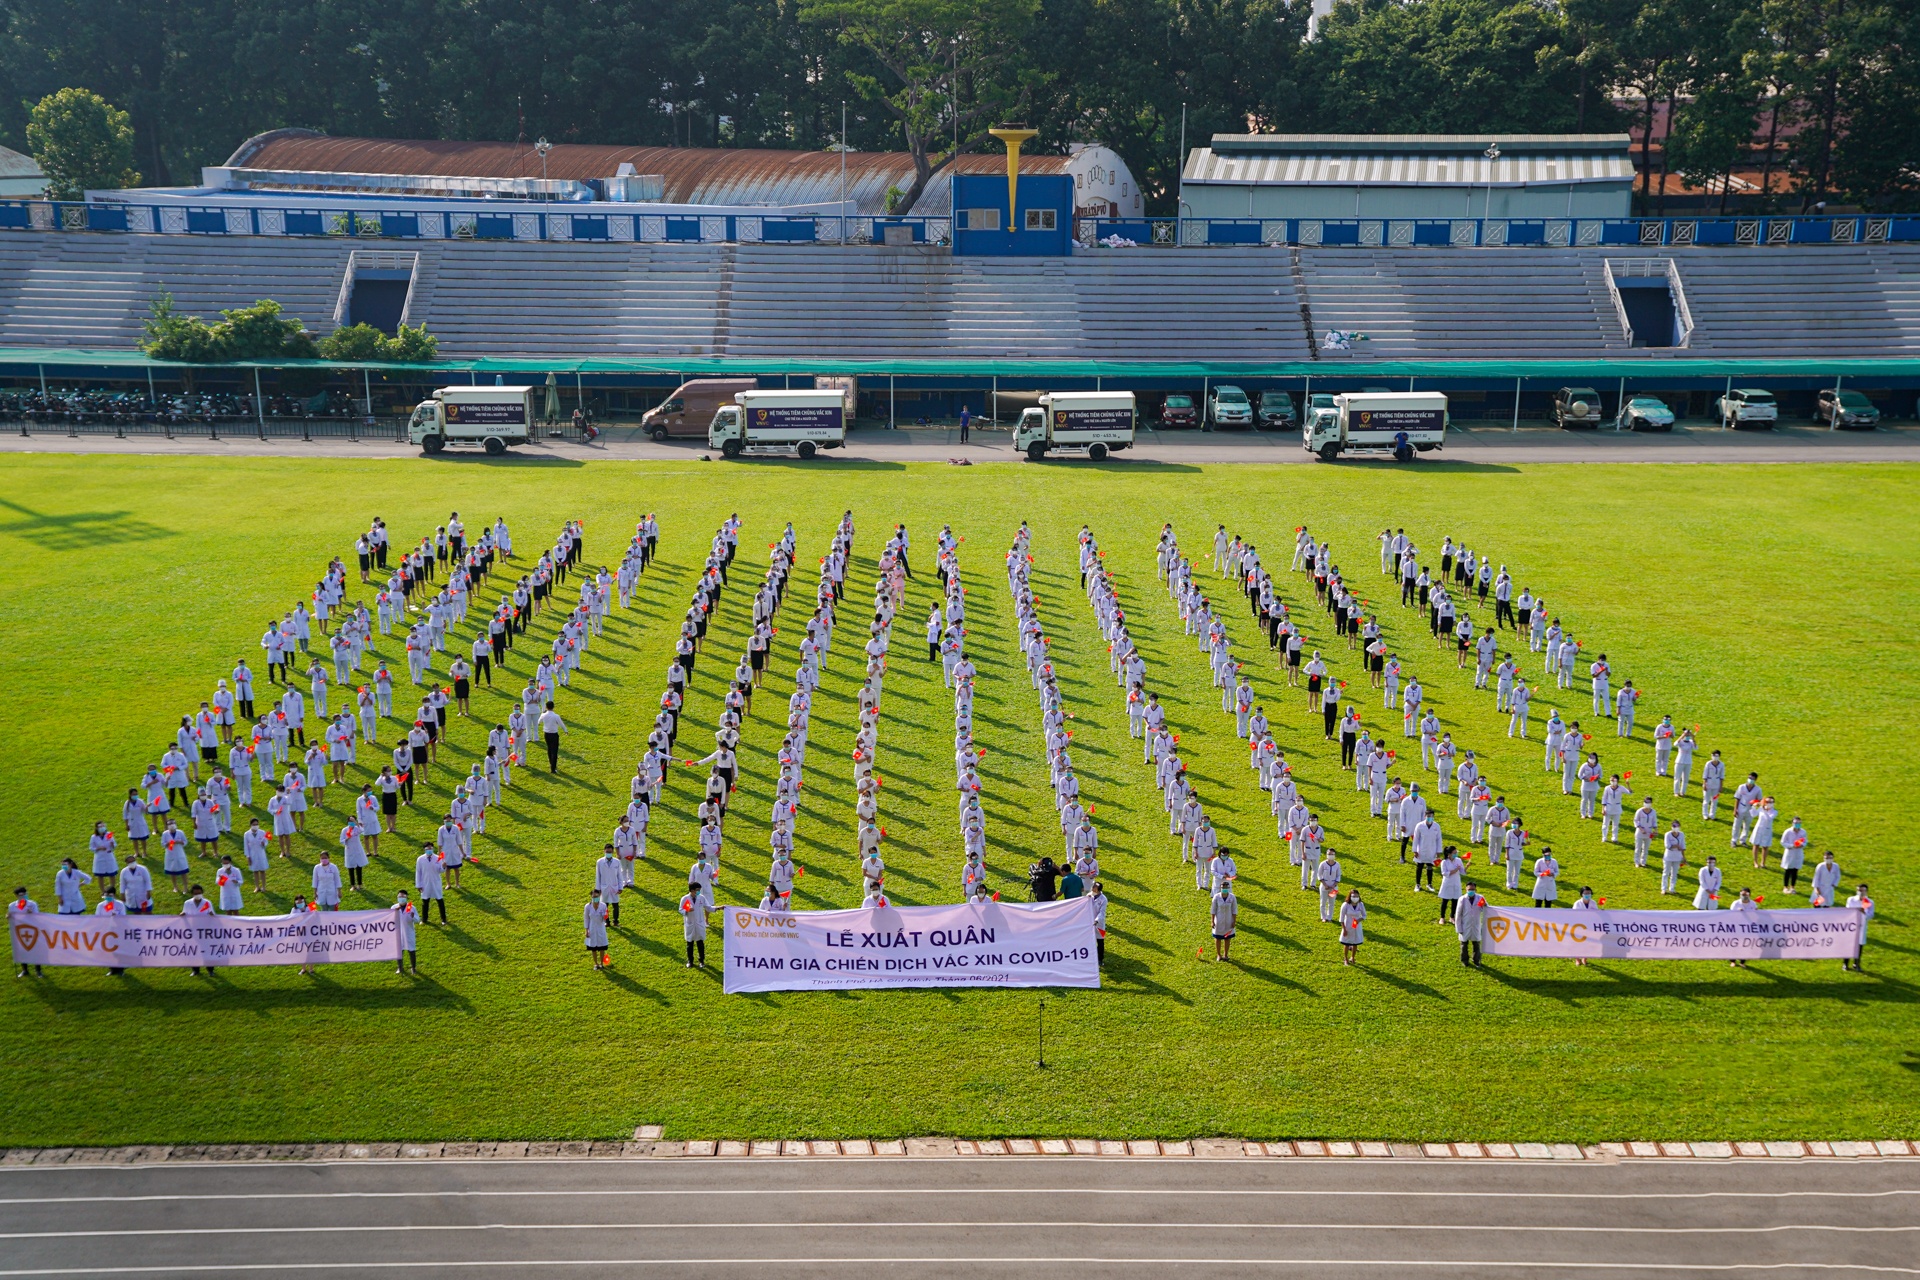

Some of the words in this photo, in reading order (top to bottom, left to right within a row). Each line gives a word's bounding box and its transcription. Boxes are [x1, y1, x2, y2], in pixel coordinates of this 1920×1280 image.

[124, 927, 141, 942] HỆ
[196, 928, 242, 939] TRUNG
[246, 925, 273, 938] TÂM
[277, 924, 307, 937] TIÊM
[310, 922, 357, 936] CHỦNG
[360, 921, 396, 934] VNVC
[753, 916, 797, 928] VNVC
[1513, 921, 1588, 943] VNVC
[1593, 922, 1611, 934] HỆ
[1661, 923, 1706, 933] TRUNG
[1709, 921, 1736, 933] TÂM
[1738, 922, 1769, 933] TIÊM
[1822, 922, 1857, 932] VNVC
[41, 929, 119, 953] VNVC
[826, 928, 854, 948] LỄ
[861, 928, 923, 948] XUẤT
[929, 924, 995, 947] QUÂN
[1664, 935, 1689, 947] TÂM
[1742, 937, 1774, 949] DỊCH
[1776, 937, 1834, 947] COVID-19
[138, 945, 158, 956] AN
[162, 943, 198, 956] TOÀN
[239, 942, 266, 955] TÂM
[276, 939, 331, 954] CHUYÊN
[333, 938, 384, 952] NGHIỆP
[733, 955, 784, 970] THAM
[789, 958, 821, 970] GIA
[885, 958, 927, 972] DỊCH
[974, 954, 1003, 966] XIN
[1008, 947, 1089, 965] COVID-19
